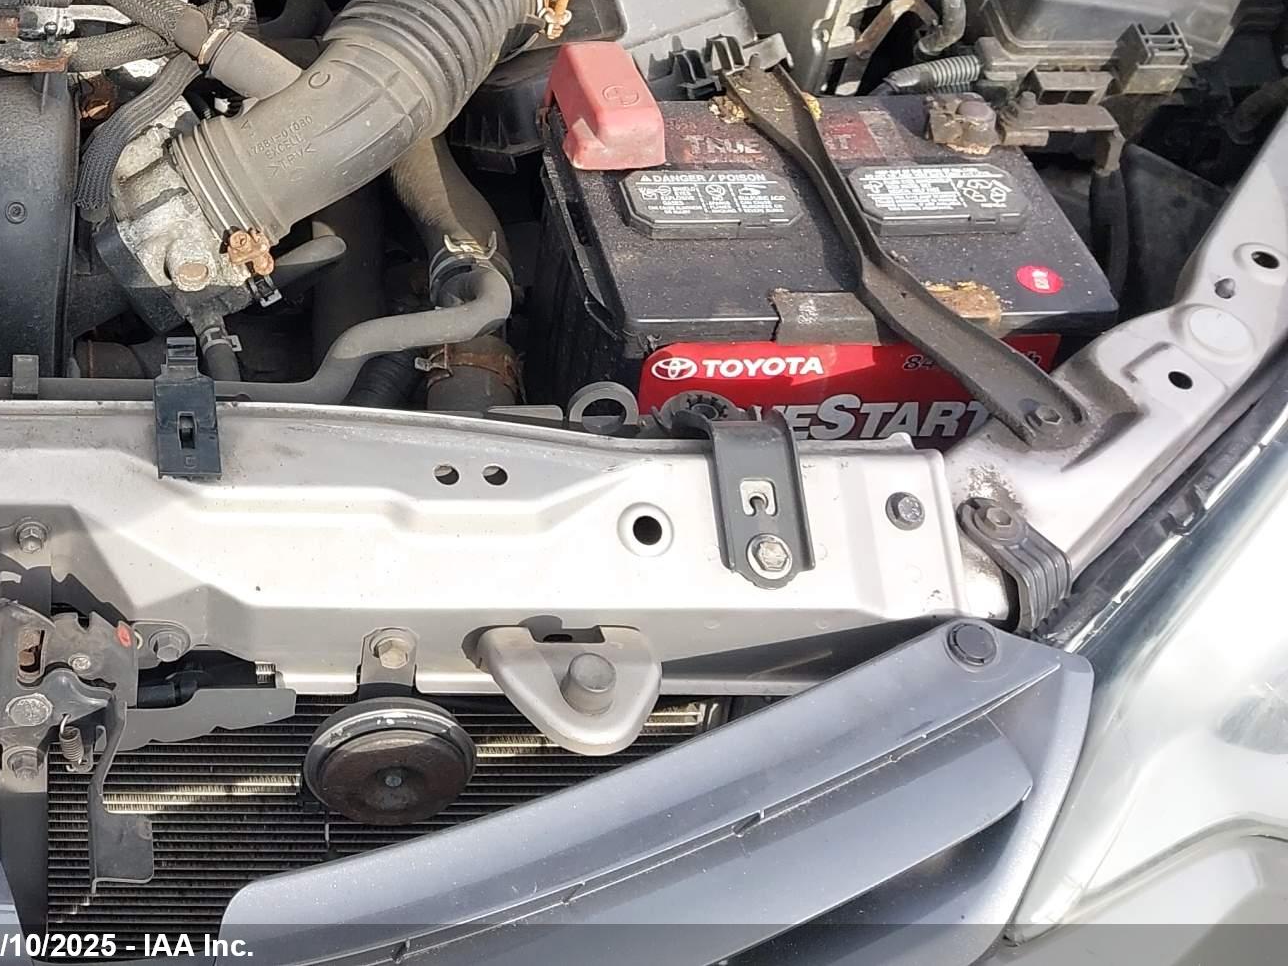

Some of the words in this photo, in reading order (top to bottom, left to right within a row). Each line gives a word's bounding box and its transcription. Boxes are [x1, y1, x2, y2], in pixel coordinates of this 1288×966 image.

[652, 174, 706, 183] DANGER
[718, 174, 767, 182] POISON
[701, 356, 825, 378] TOYOTA
